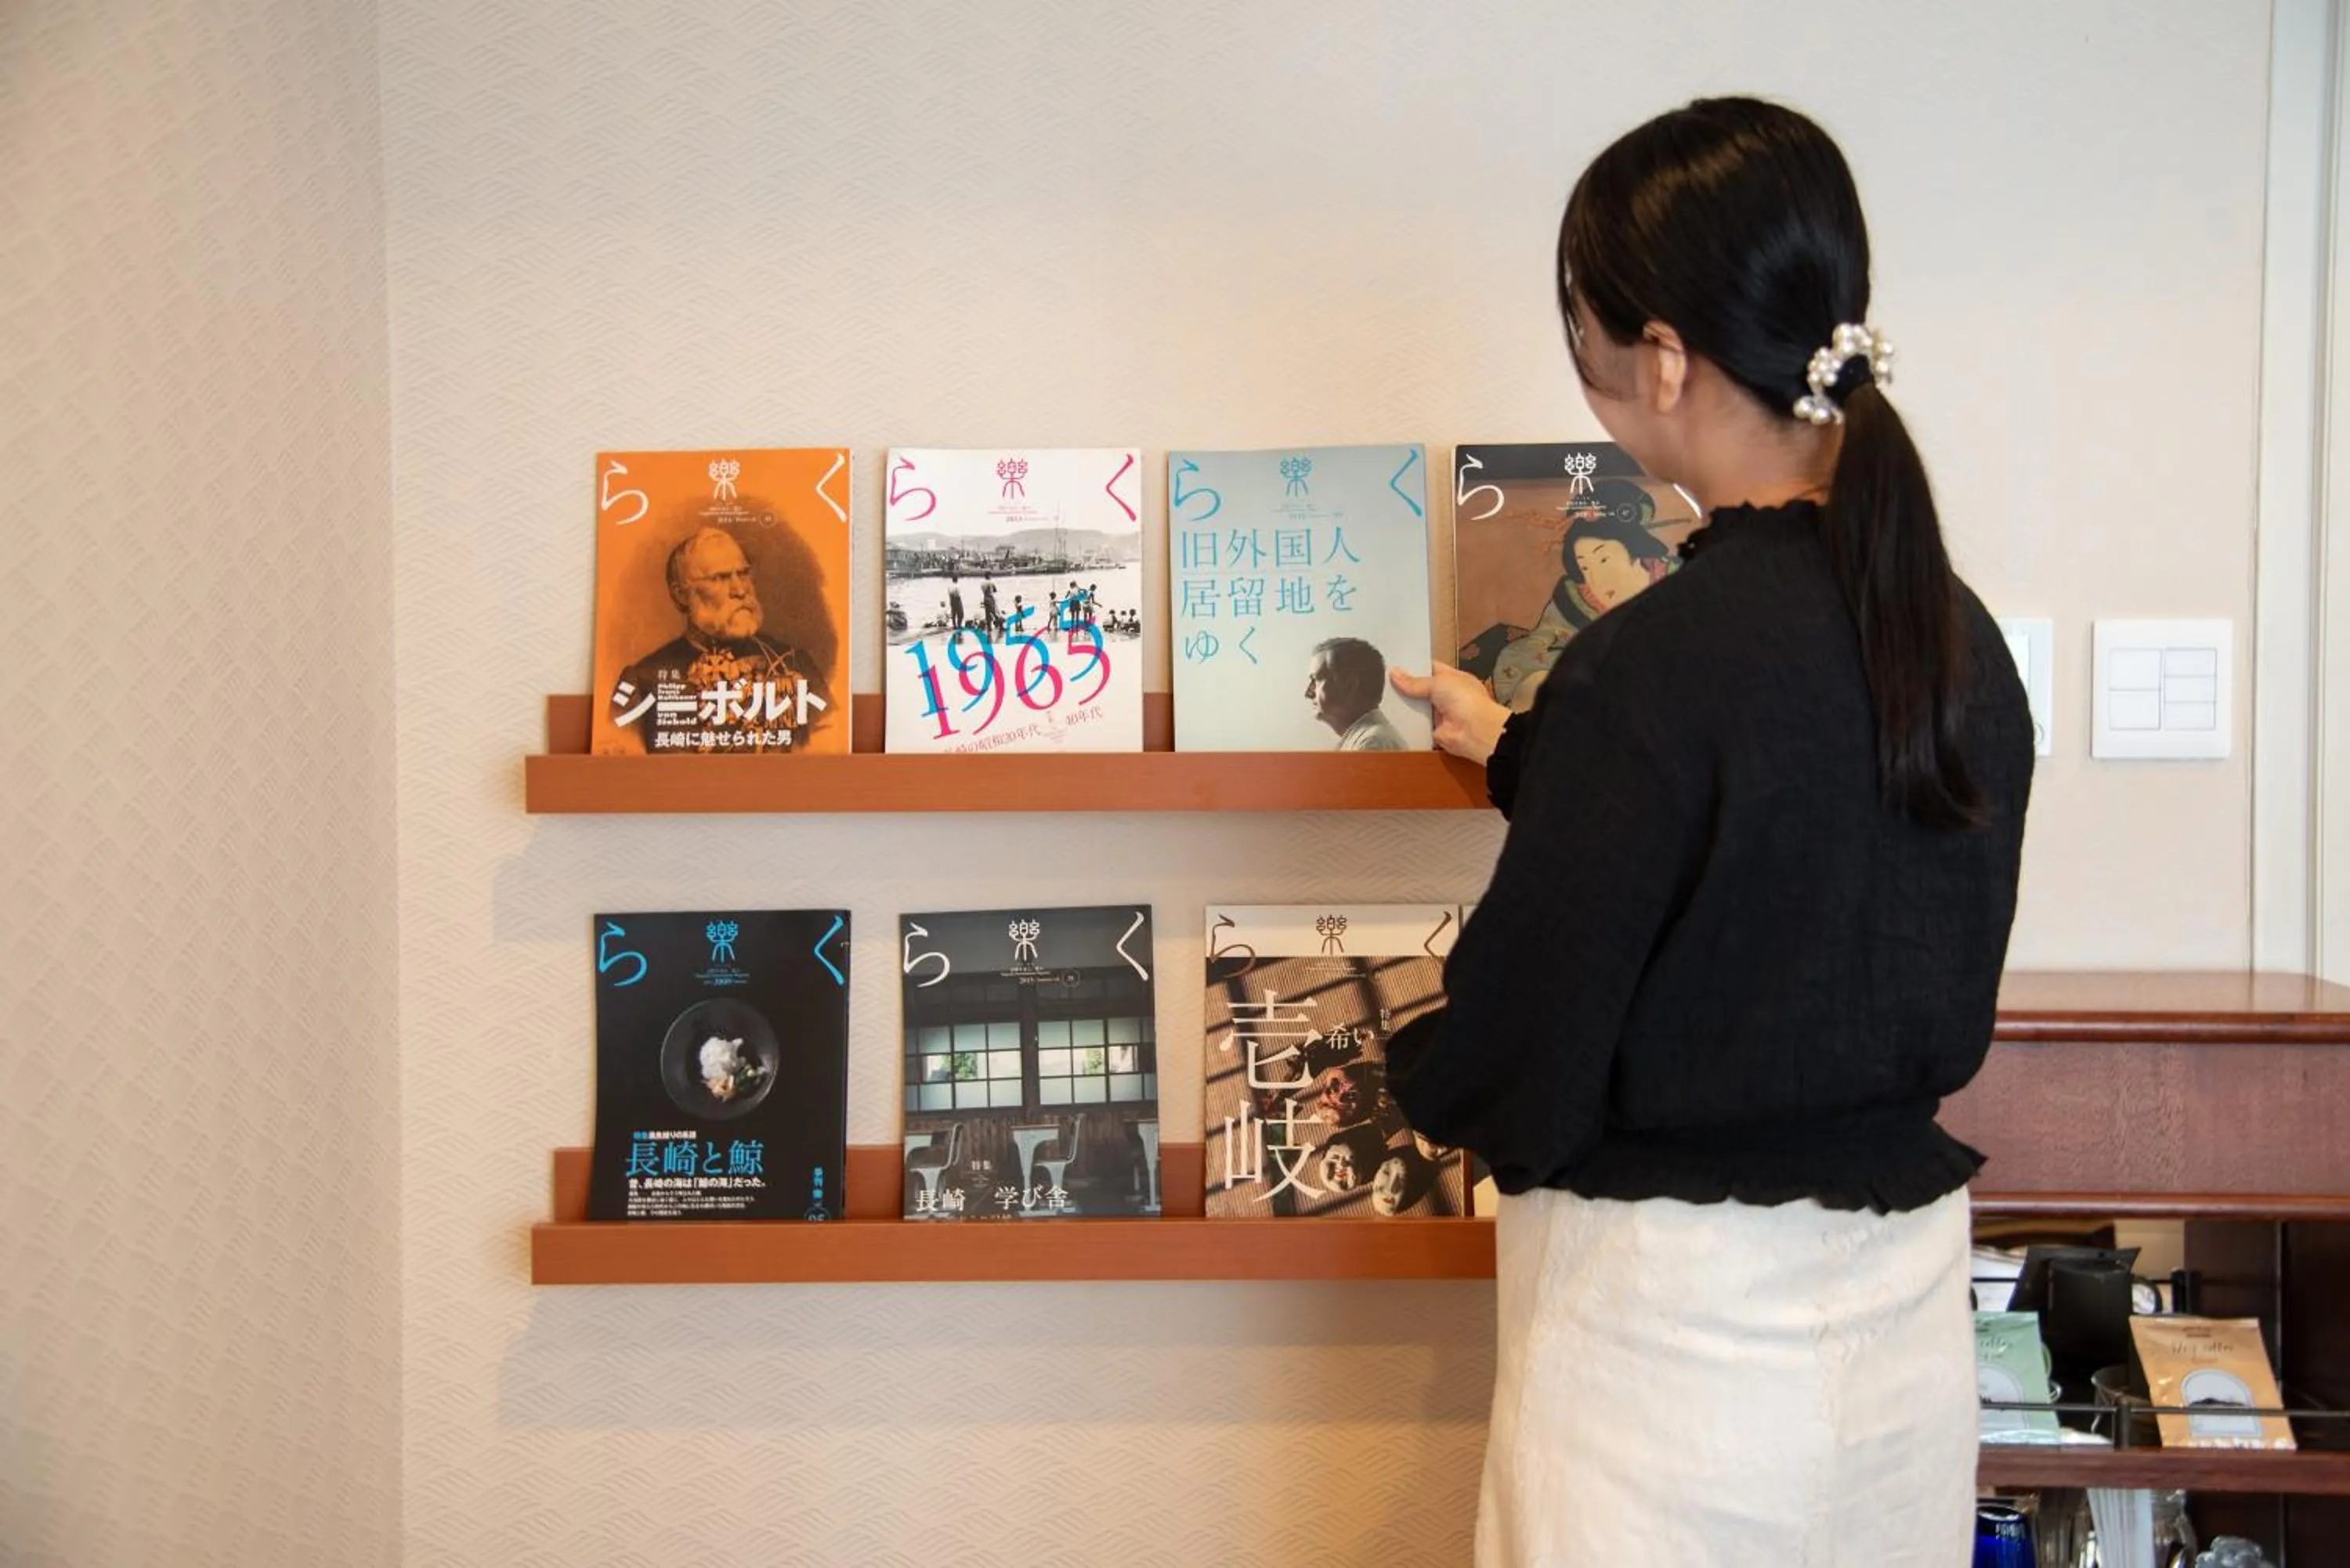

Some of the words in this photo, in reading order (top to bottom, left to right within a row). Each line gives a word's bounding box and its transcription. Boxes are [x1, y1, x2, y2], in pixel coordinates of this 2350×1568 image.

[601, 460, 649, 525] ら
[815, 452, 848, 522] く
[889, 456, 937, 522] ら
[1104, 453, 1137, 522] く
[1173, 459, 1221, 522] ら
[1388, 449, 1423, 518] く
[1458, 453, 1505, 521] ら
[1181, 526, 1361, 569] 旧外国人
[1180, 574, 1357, 620] 居留地を
[905, 588, 1104, 718] 1955
[917, 616, 1112, 740] 1965
[1185, 626, 1258, 665] ゆく
[613, 678, 827, 728] シーボルト
[655, 730, 792, 748] 長崎に魅せられた男
[598, 920, 648, 987] ら
[813, 915, 846, 986] く
[903, 922, 950, 988] ら
[1116, 911, 1148, 981] く
[1210, 913, 1254, 978] ら
[1325, 1023, 1374, 1050] 希い
[1219, 990, 1327, 1202] 壱岐
[625, 1140, 765, 1176] 長崎と鯨
[916, 1187, 966, 1212] 長崎
[994, 1184, 1068, 1210] 学び舎
